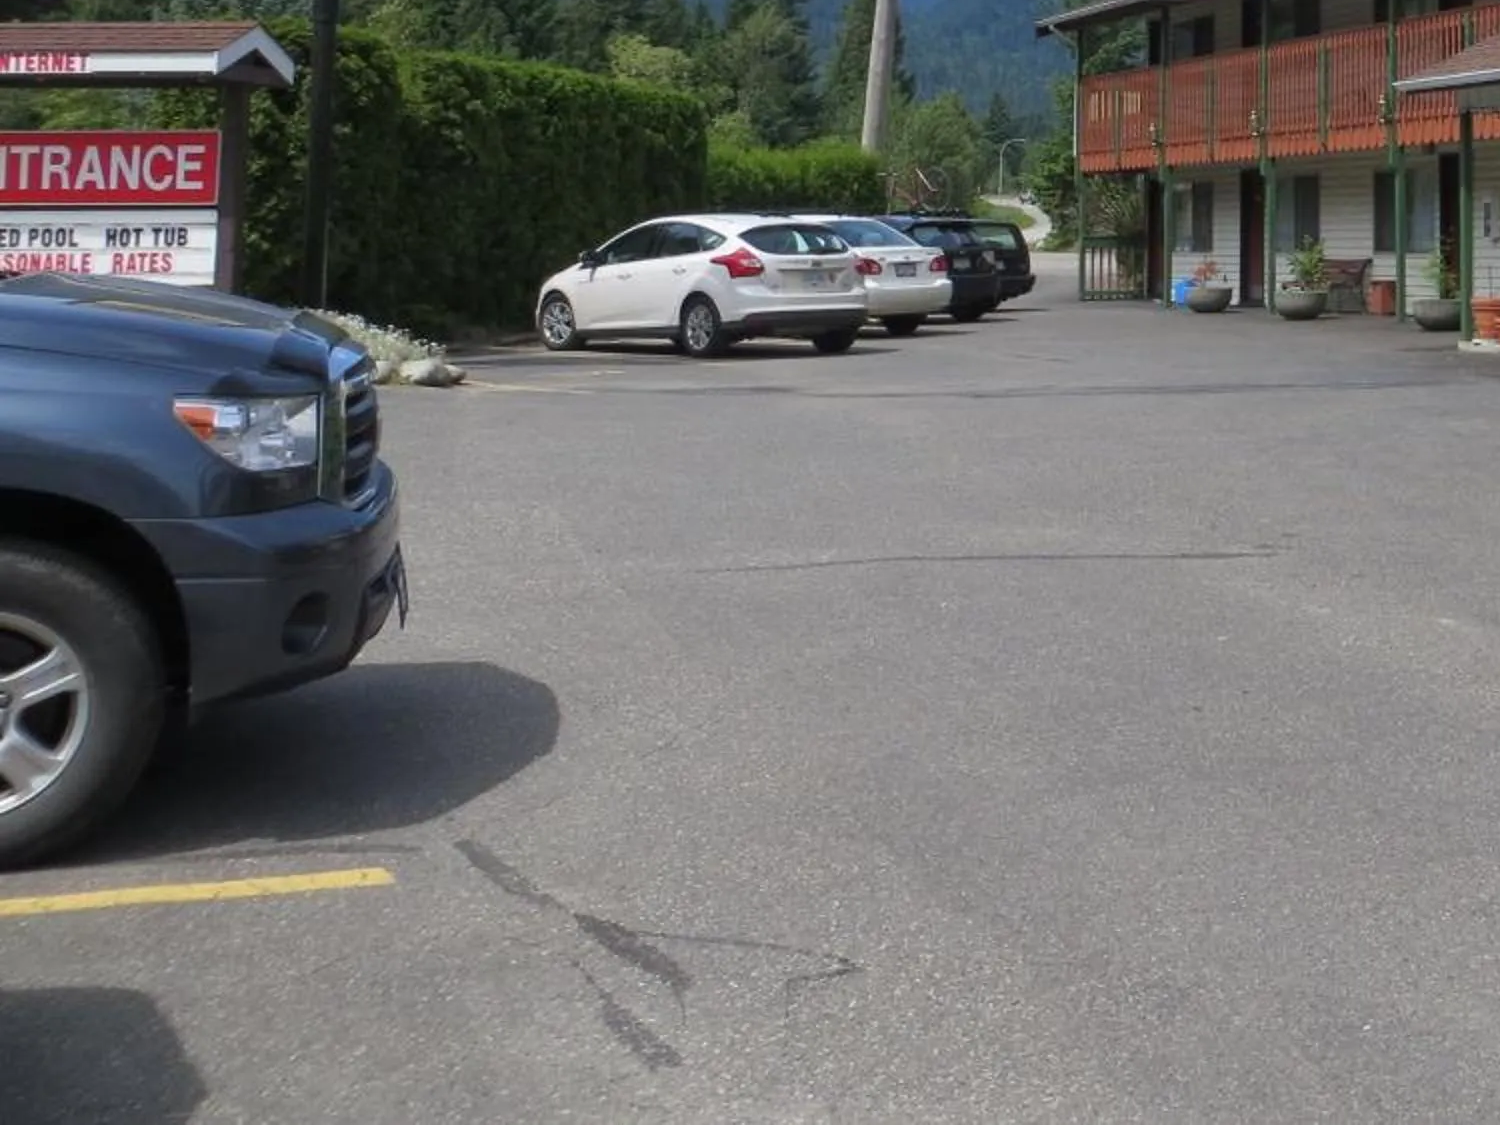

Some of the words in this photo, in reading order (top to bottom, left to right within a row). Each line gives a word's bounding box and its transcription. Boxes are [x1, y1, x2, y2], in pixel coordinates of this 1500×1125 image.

[28, 228, 78, 248] POOL
[105, 228, 144, 248] HOT
[151, 227, 188, 247] TUB
[112, 252, 173, 272] RATES
